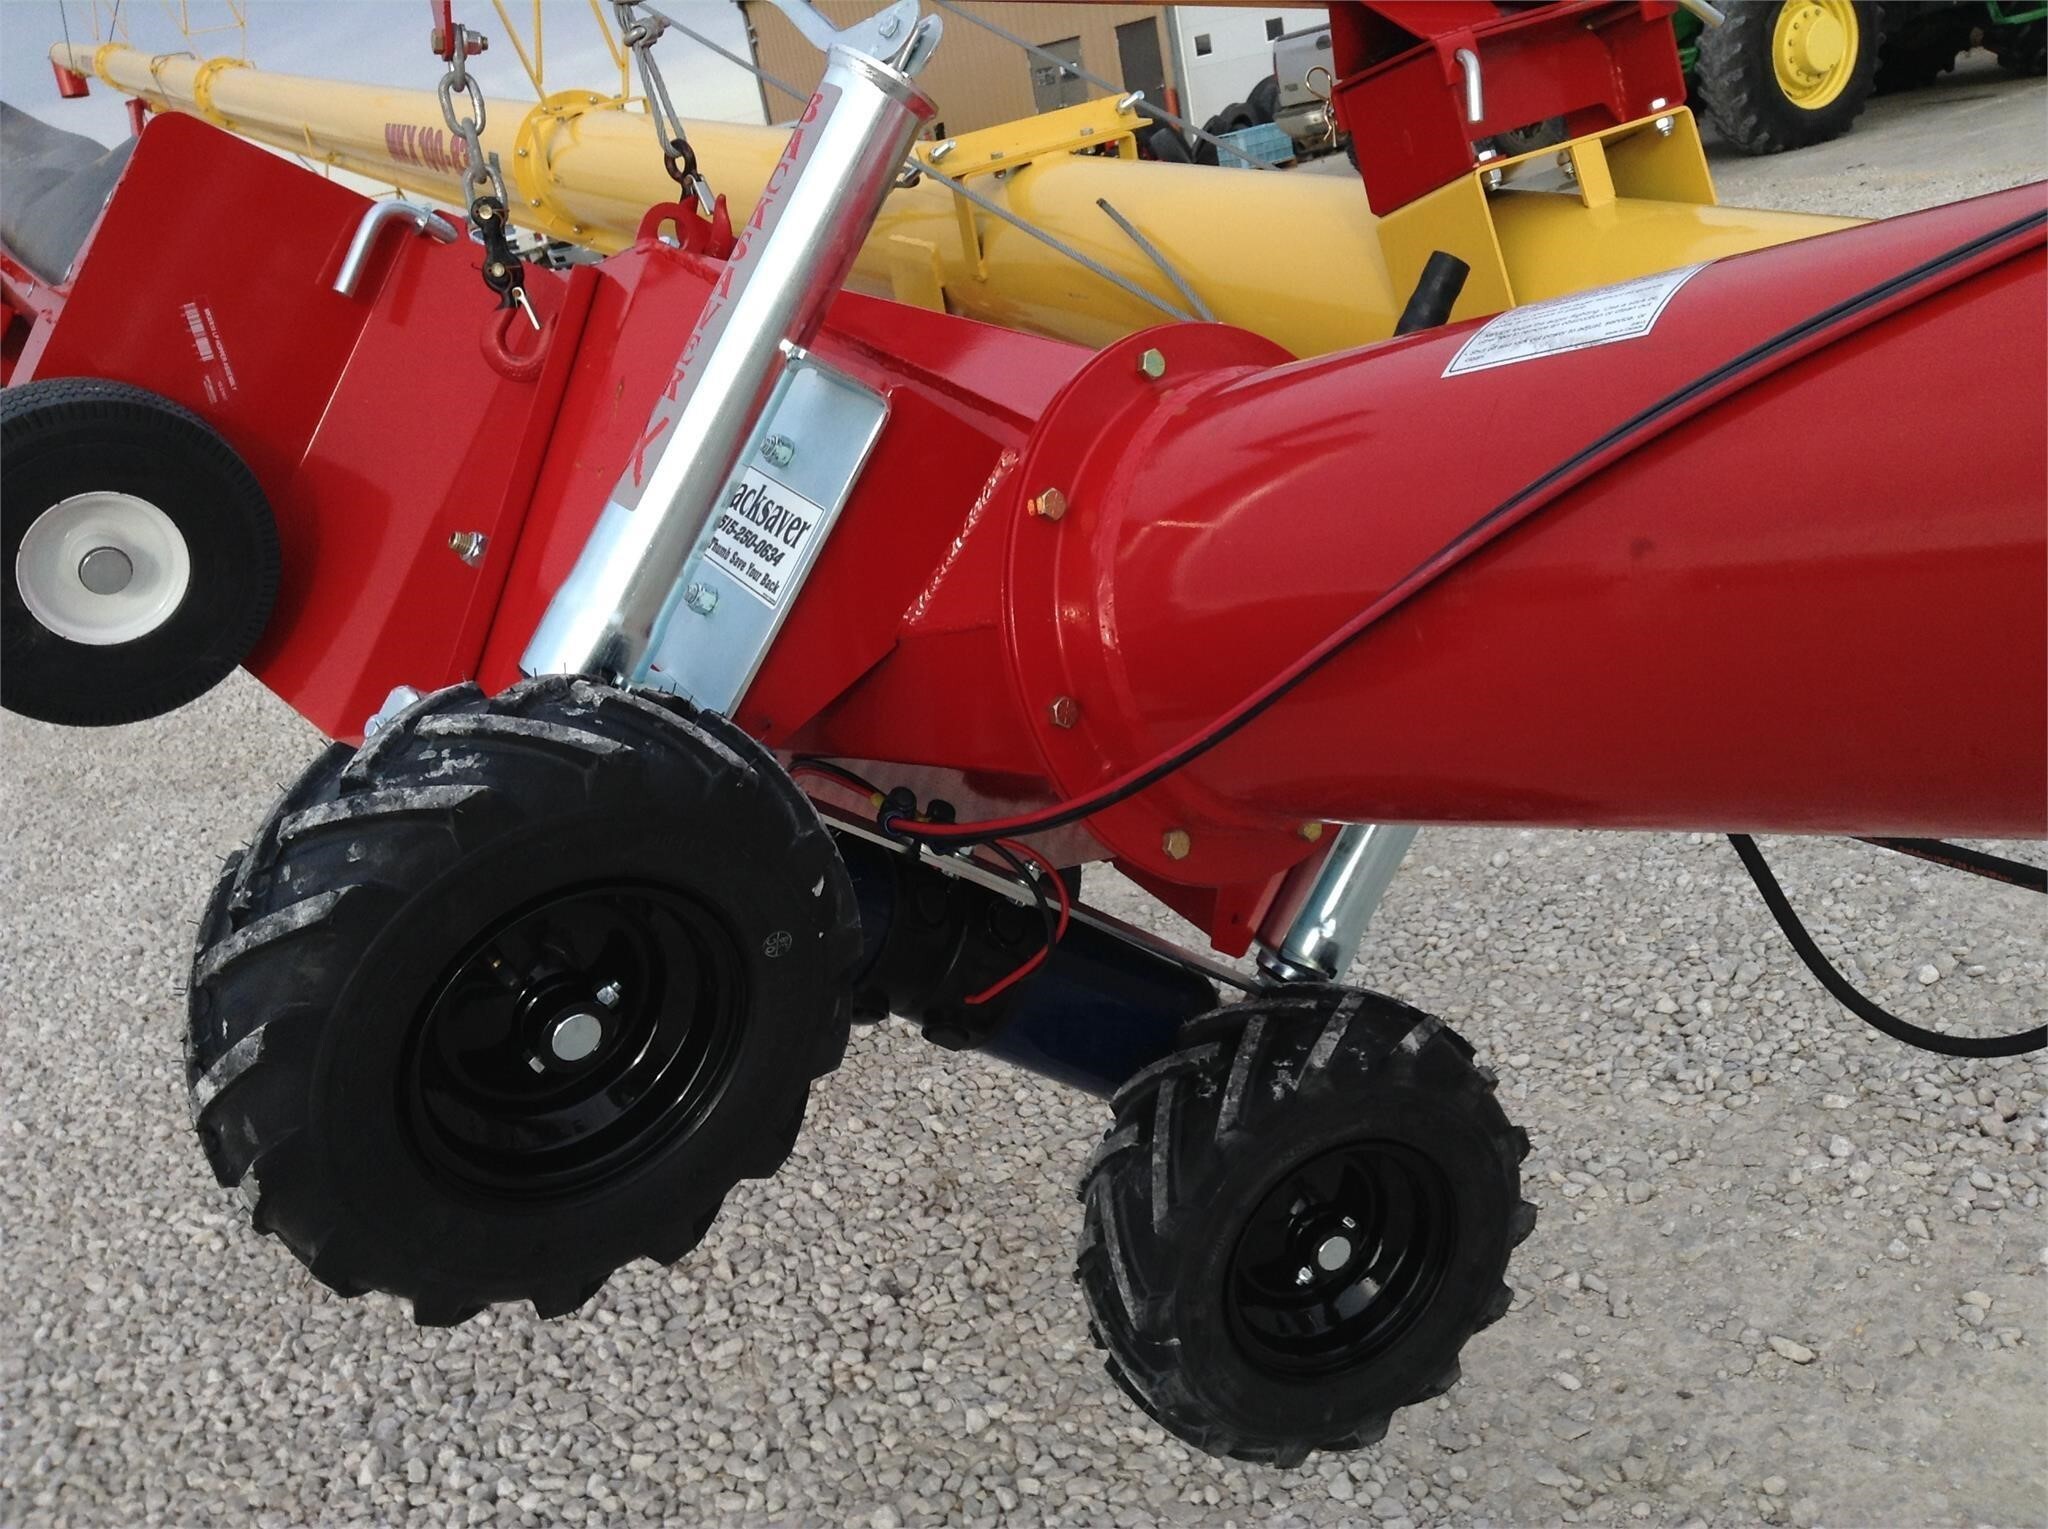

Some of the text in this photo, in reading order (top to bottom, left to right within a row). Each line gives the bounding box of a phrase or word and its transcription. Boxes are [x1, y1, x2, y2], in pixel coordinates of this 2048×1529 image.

[717, 514, 786, 567] 515-250-0634
[728, 483, 812, 549] acksaver
[729, 551, 748, 572] Save
[745, 562, 763, 583] Your
[760, 572, 780, 595] Back
